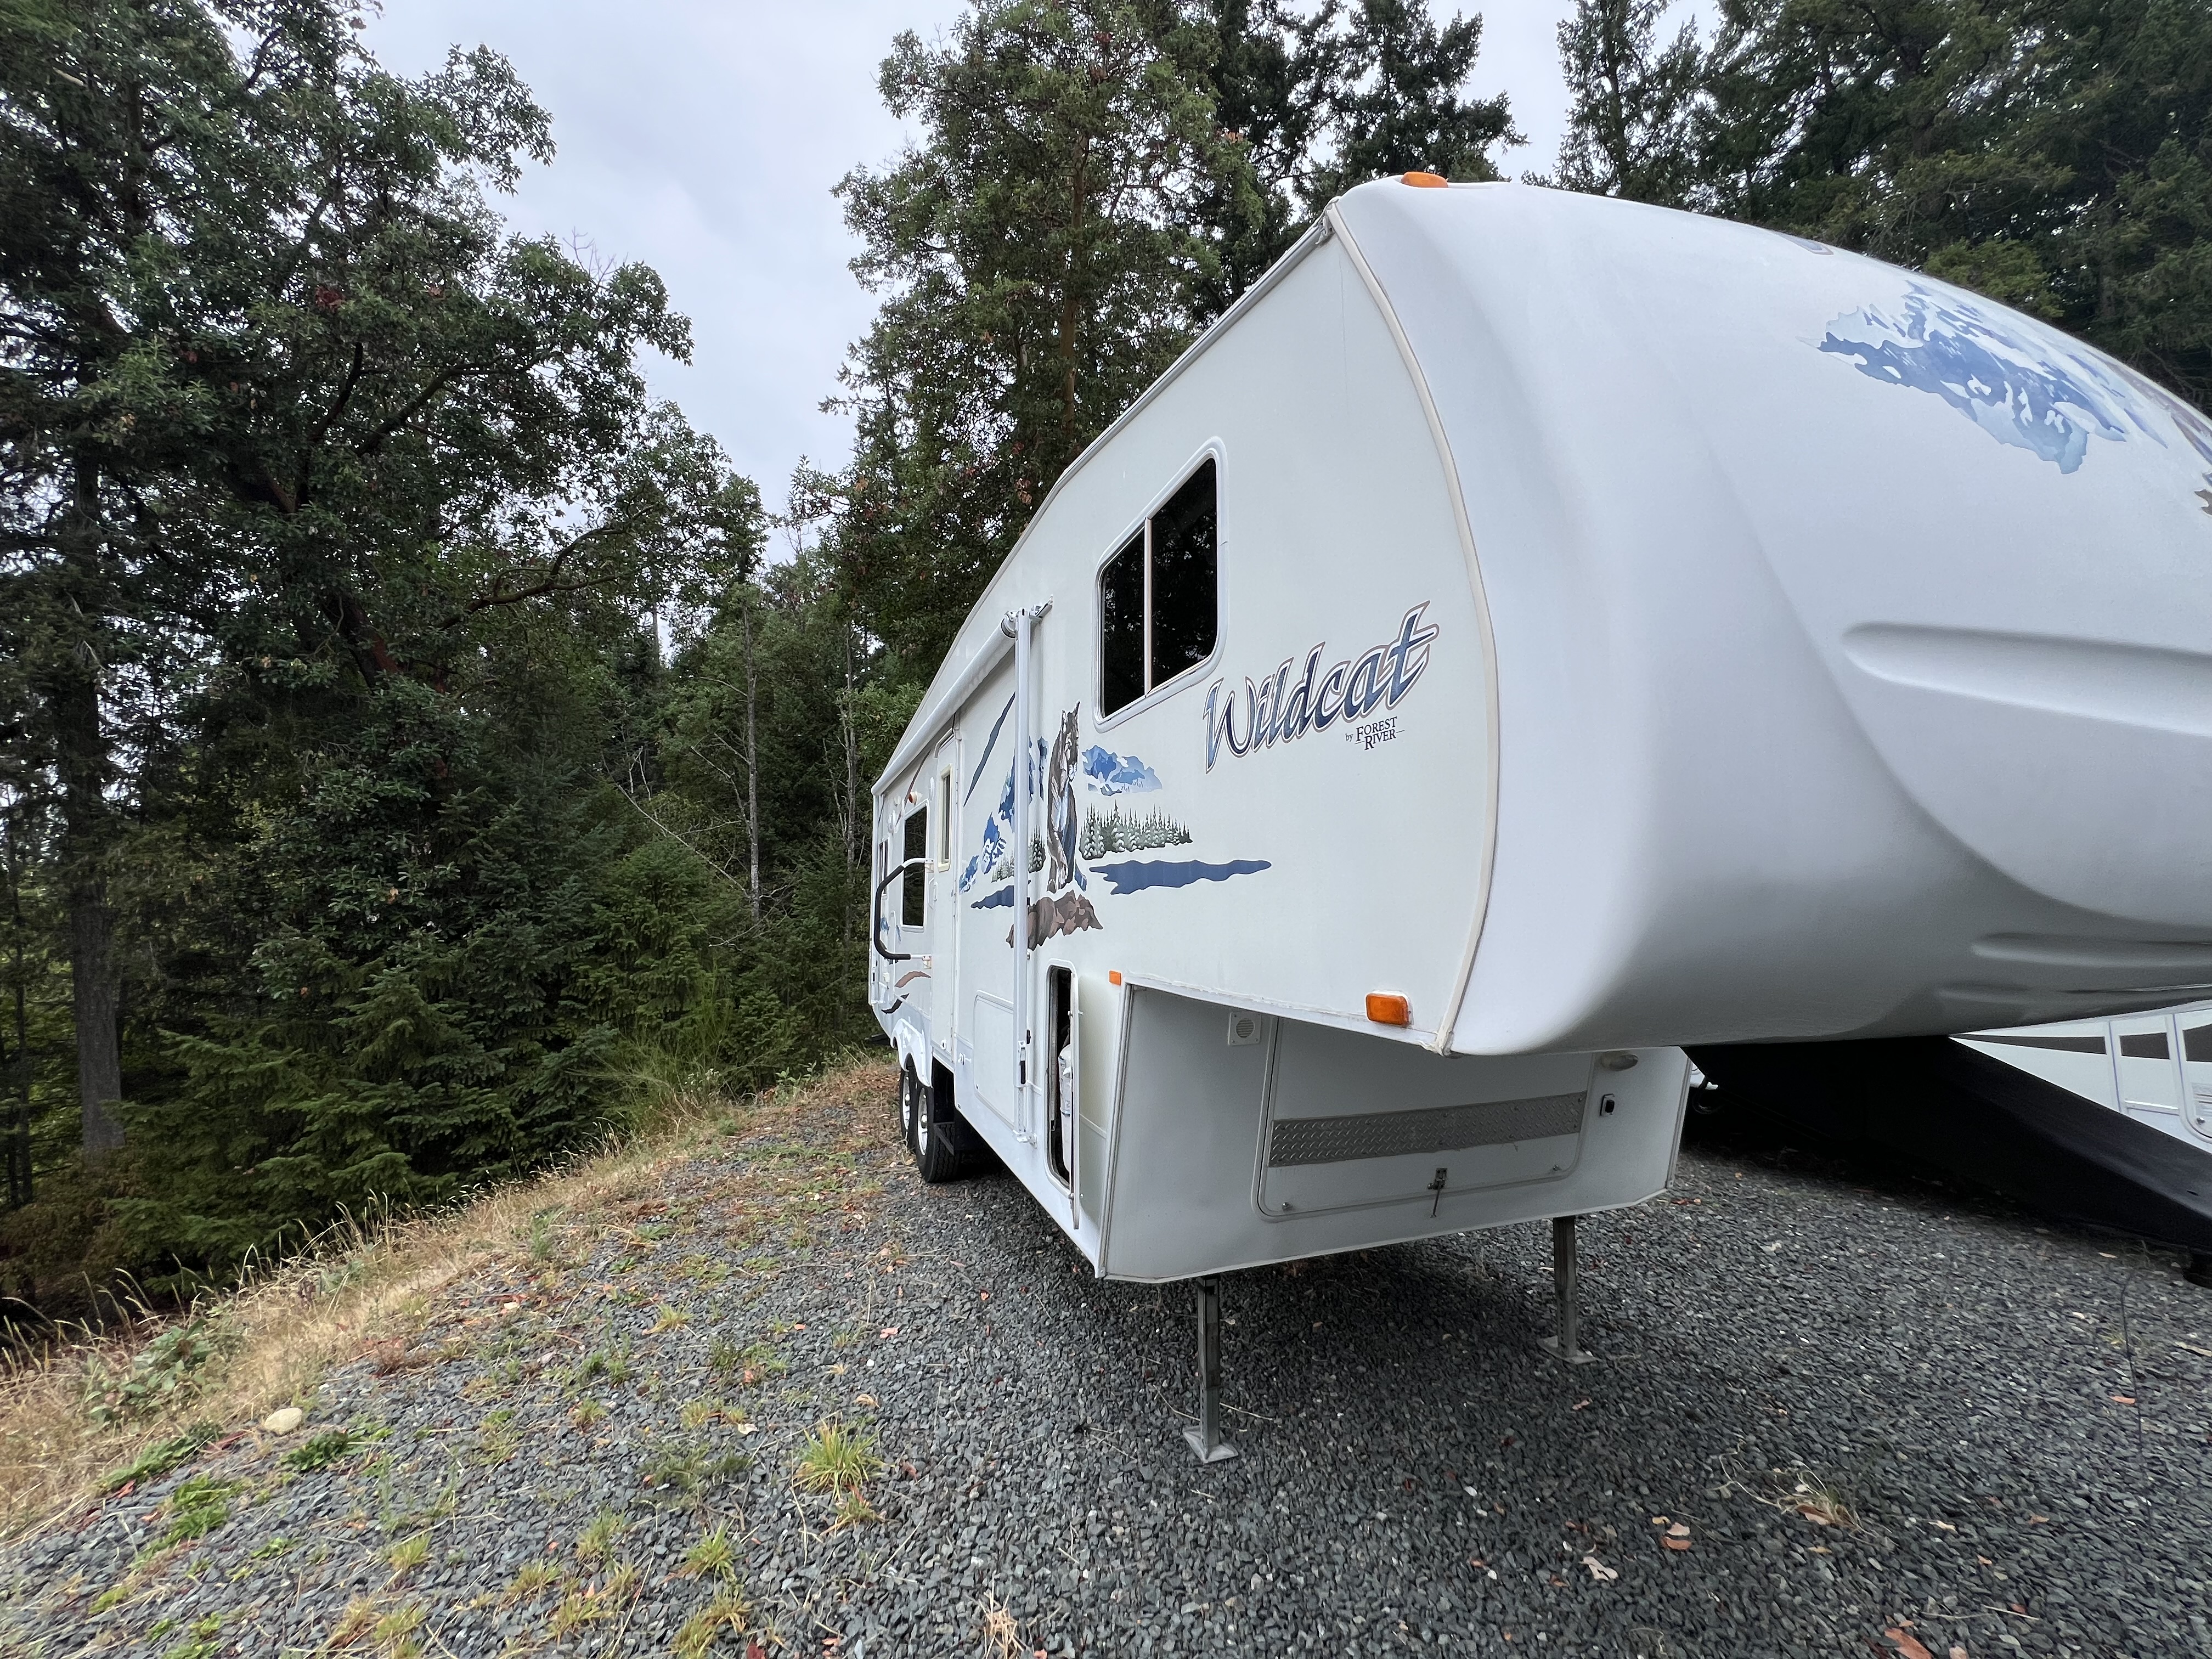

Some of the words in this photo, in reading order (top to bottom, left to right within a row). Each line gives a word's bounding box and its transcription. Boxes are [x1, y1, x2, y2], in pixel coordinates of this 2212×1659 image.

[1203, 600, 1440, 775] Wildcat
[1345, 733, 1353, 742] by
[1356, 716, 1397, 742] FOREST
[1364, 729, 1397, 751] RIVER
